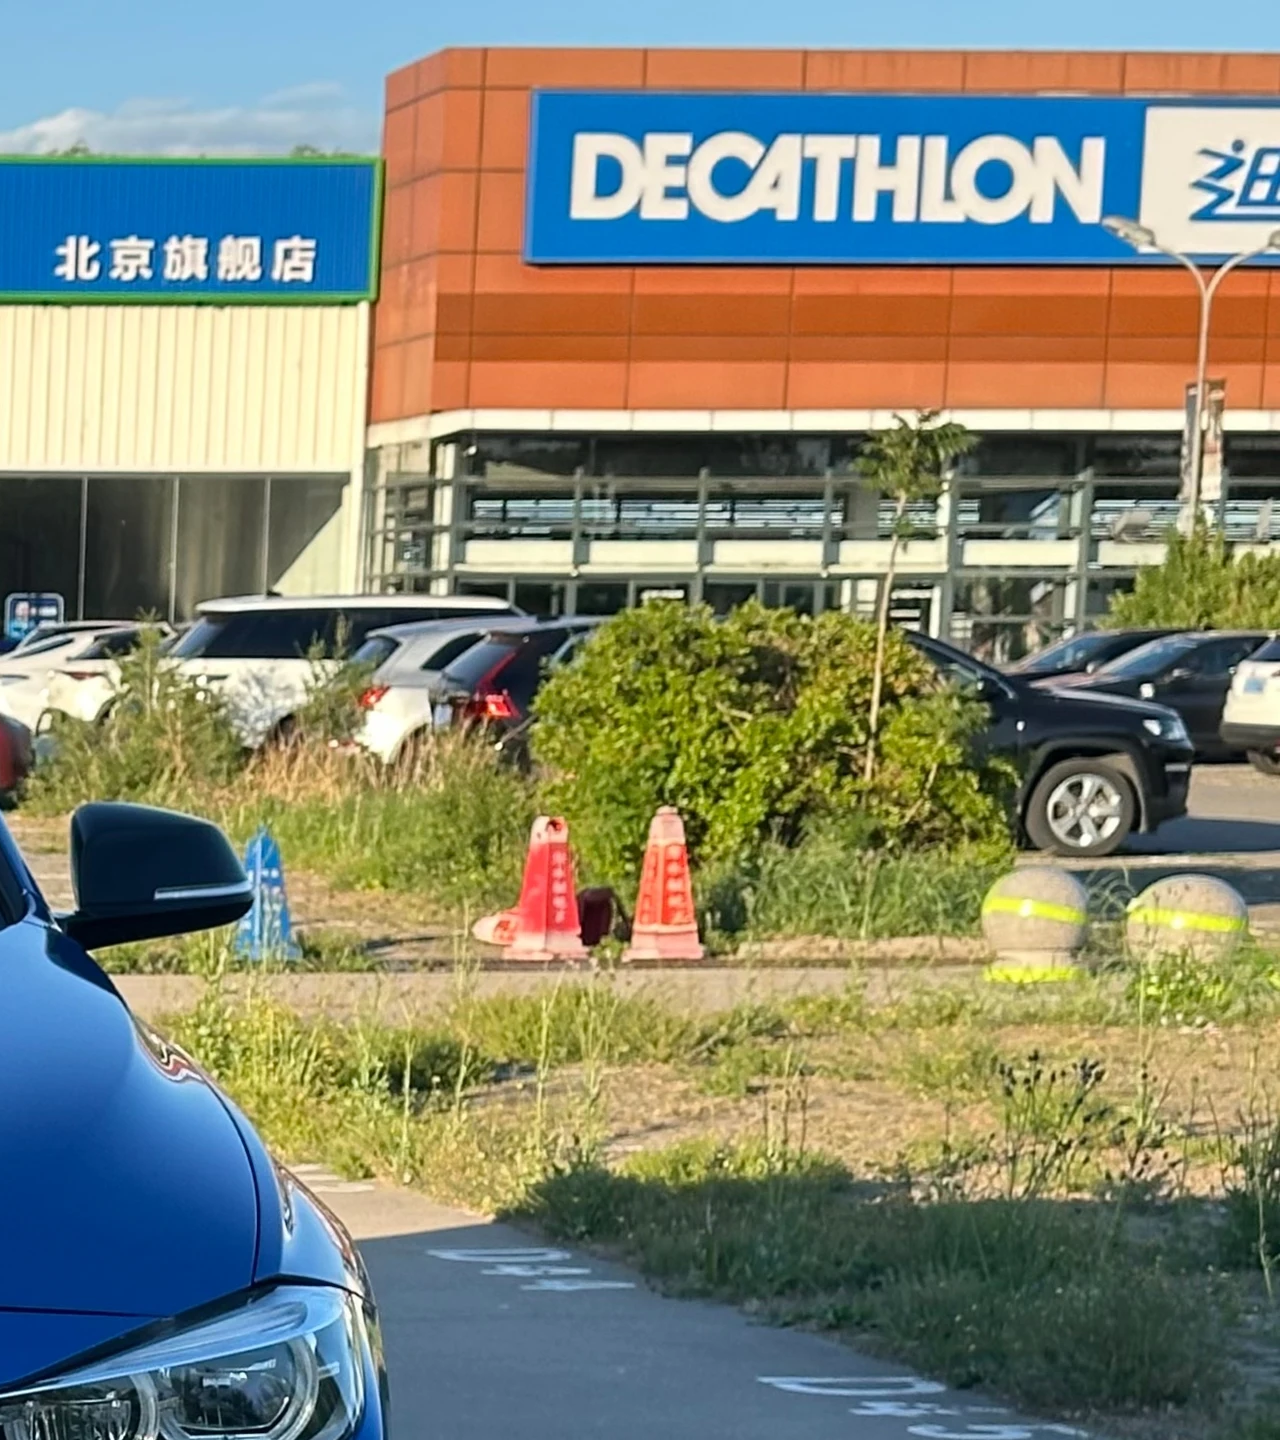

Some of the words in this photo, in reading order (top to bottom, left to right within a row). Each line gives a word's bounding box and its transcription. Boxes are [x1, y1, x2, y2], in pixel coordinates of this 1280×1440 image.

[569, 130, 1107, 225] DECATHLON
[54, 235, 317, 282] 北京旗舰店
